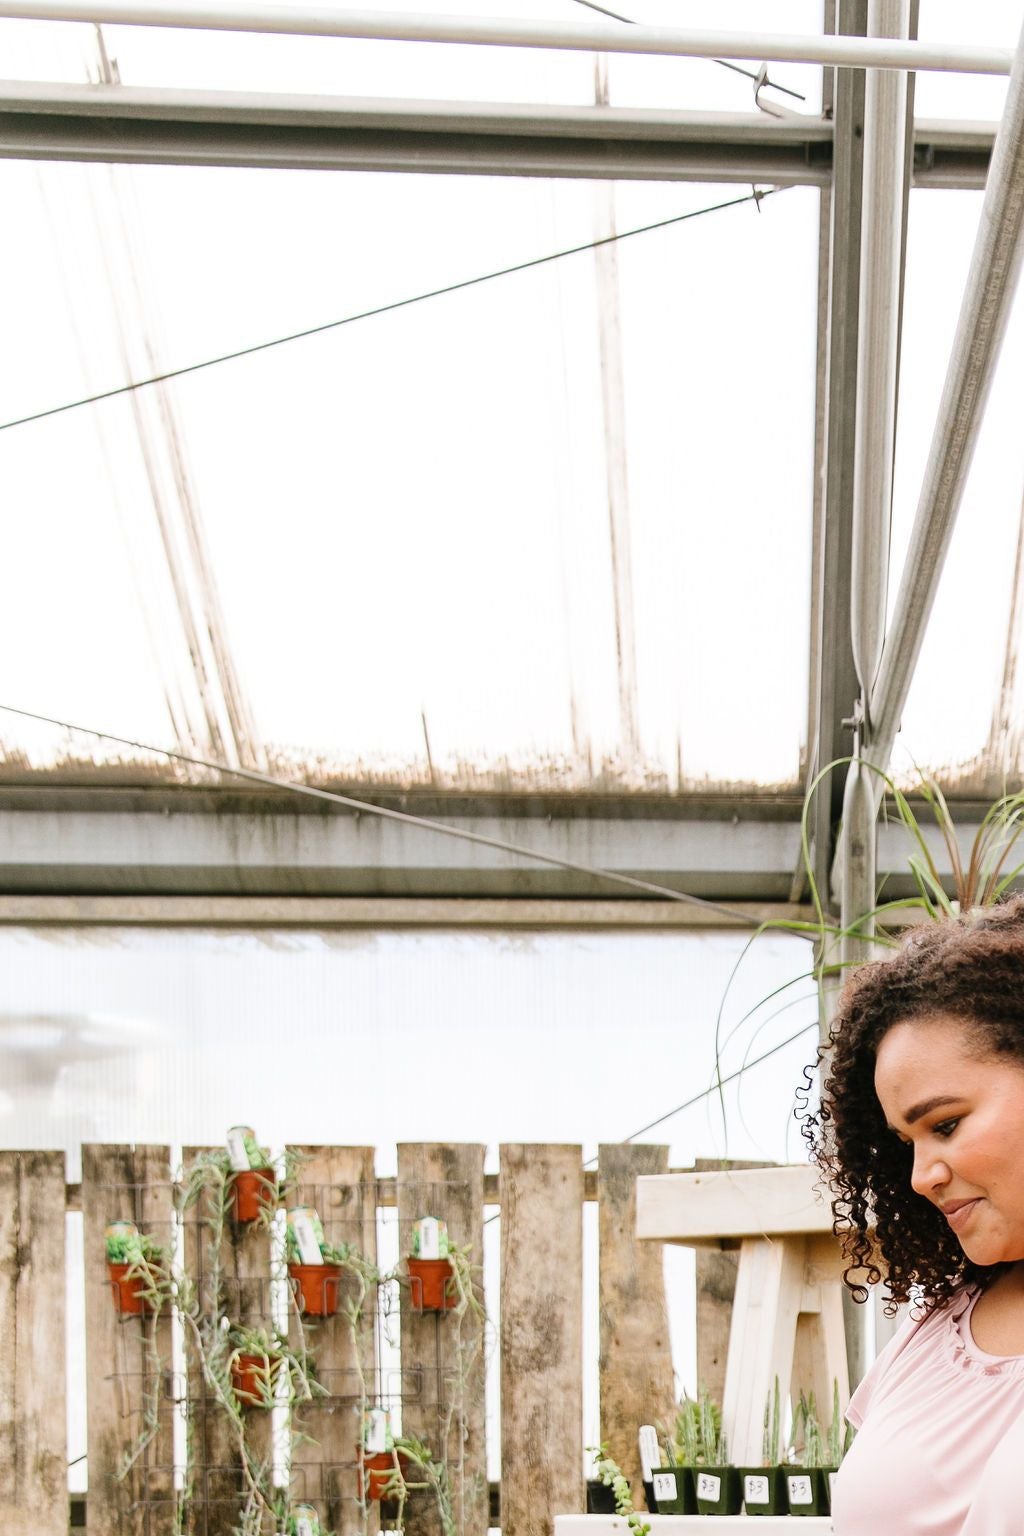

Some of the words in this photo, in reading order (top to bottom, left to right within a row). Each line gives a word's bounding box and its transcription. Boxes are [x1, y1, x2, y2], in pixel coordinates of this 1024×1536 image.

[701, 1478, 716, 1493] $3
[748, 1479, 764, 1496] $3
[791, 1480, 807, 1497] $3
